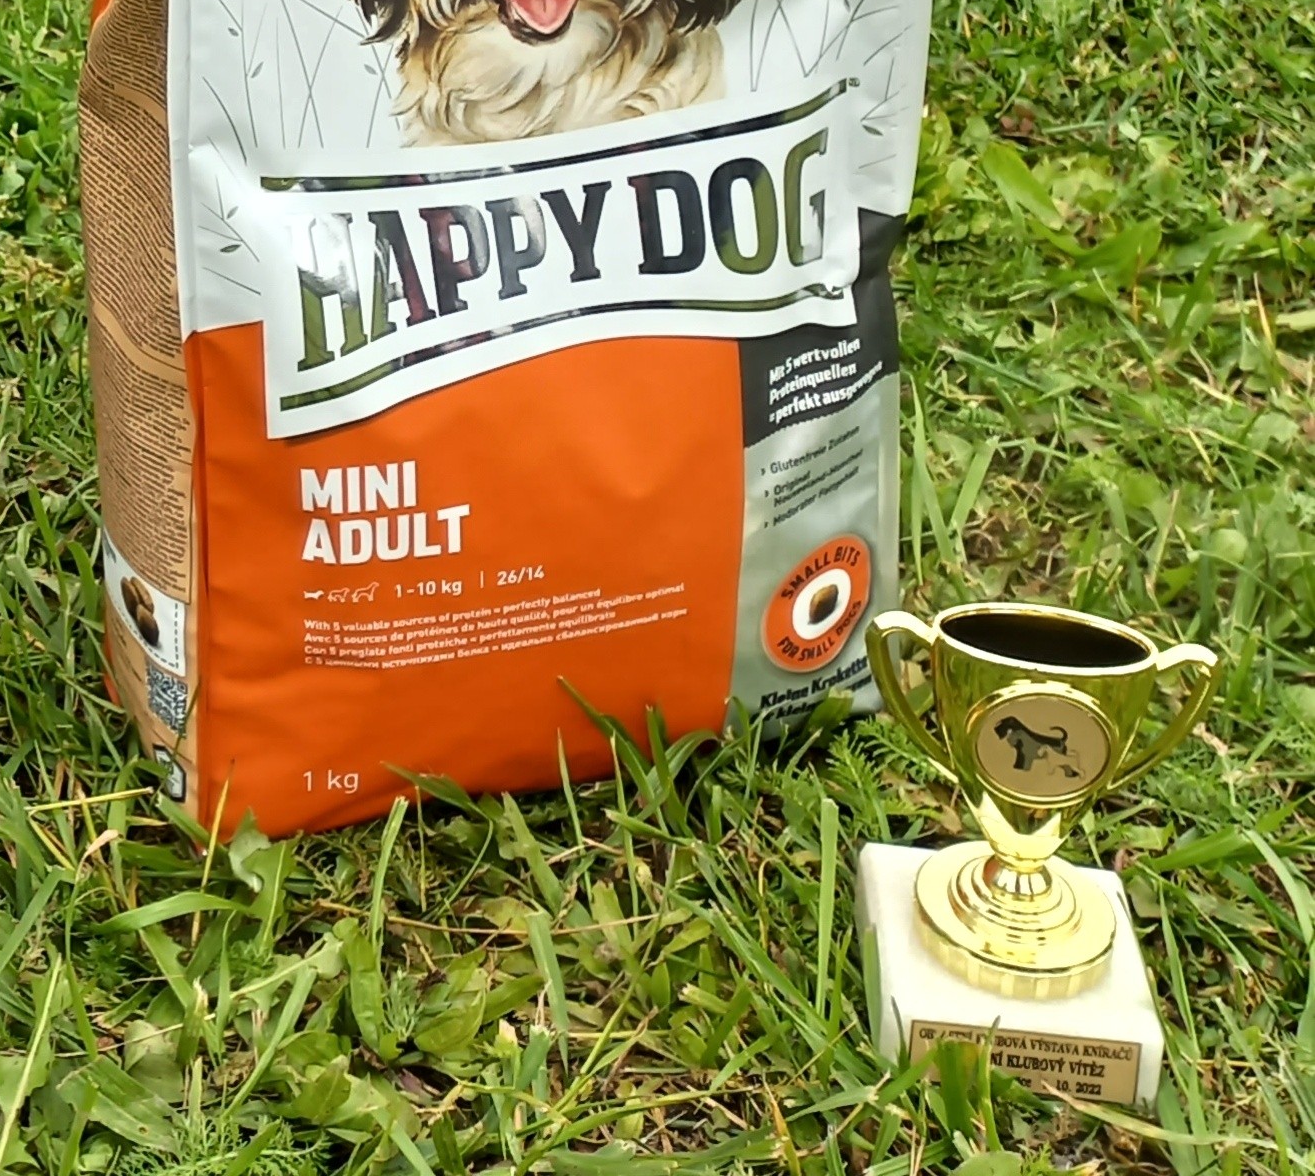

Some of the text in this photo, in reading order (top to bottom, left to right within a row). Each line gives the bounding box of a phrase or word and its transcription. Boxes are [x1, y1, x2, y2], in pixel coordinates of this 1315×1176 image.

[293, 180, 613, 373] HAPPY
[627, 127, 830, 276] DOG
[769, 338, 861, 385] Mit 5 wertvollen
[769, 363, 857, 405] Proteinquellen
[776, 392, 822, 424] perfekt
[300, 460, 417, 515] MINI
[301, 504, 471, 565] ADULT
[441, 579, 463, 597] kg
[496, 564, 545, 586] 26/14
[781, 546, 861, 600] SMALL BITS
[304, 619, 331, 631] With
[334, 621, 341, 632] 5
[343, 620, 391, 631] valuable
[393, 615, 437, 628] sources
[439, 612, 451, 623] of
[452, 608, 492, 623] protein
[503, 595, 552, 614] perfectly
[553, 588, 601, 605] balanced
[304, 633, 332, 644] Avec
[334, 633, 341, 644] 5
[343, 632, 388, 644] sources
[390, 631, 404, 642] de
[406, 624, 459, 641] protéines
[461, 622, 475, 633] de
[476, 617, 508, 630] haute
[553, 605, 578, 619] pour
[580, 602, 594, 613] un
[777, 600, 862, 662] FOR SMALL DOGS
[304, 645, 327, 655] Con
[329, 646, 336, 656] 5
[388, 643, 414, 656] fonti
[760, 686, 809, 709] Kleine
[303, 769, 359, 794] 1 kg
[1007, 1051, 1066, 1073] KLUBOVÝ
[1070, 1058, 1106, 1078] VÍTĚZ
[1030, 1036, 1080, 1056] VÝSTAVA
[1083, 1043, 1134, 1062] KNÍRAČŮ
[1056, 1079, 1071, 1092] 10.
[1075, 1080, 1102, 1096] 2022
